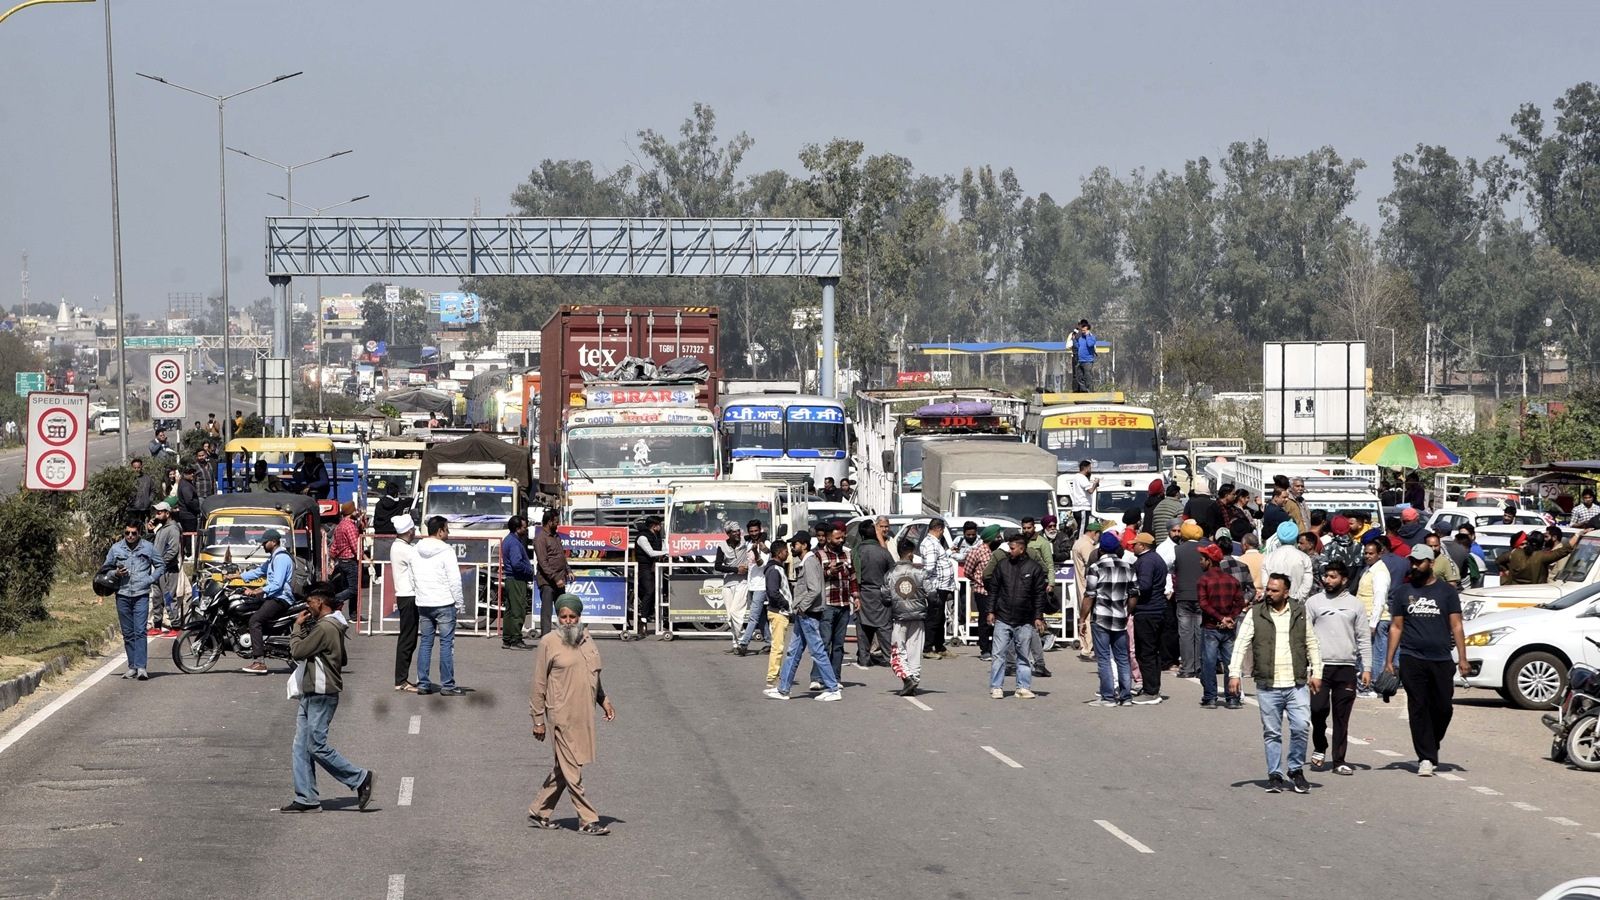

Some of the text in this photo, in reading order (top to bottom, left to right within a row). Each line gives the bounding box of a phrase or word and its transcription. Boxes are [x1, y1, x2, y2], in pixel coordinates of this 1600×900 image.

[682, 345, 704, 354] 577322
[578, 343, 617, 367] tex
[161, 370, 175, 379] 90
[612, 389, 672, 404] BRAR
[32, 397, 85, 406] SPEED LIMIT
[161, 400, 175, 409] 65
[588, 415, 614, 425] GOODS
[940, 416, 978, 427] JDL
[569, 530, 593, 538] STOP
[571, 539, 606, 548] CHECKING
[671, 536, 701, 553] ਪੁਲਿਸ
